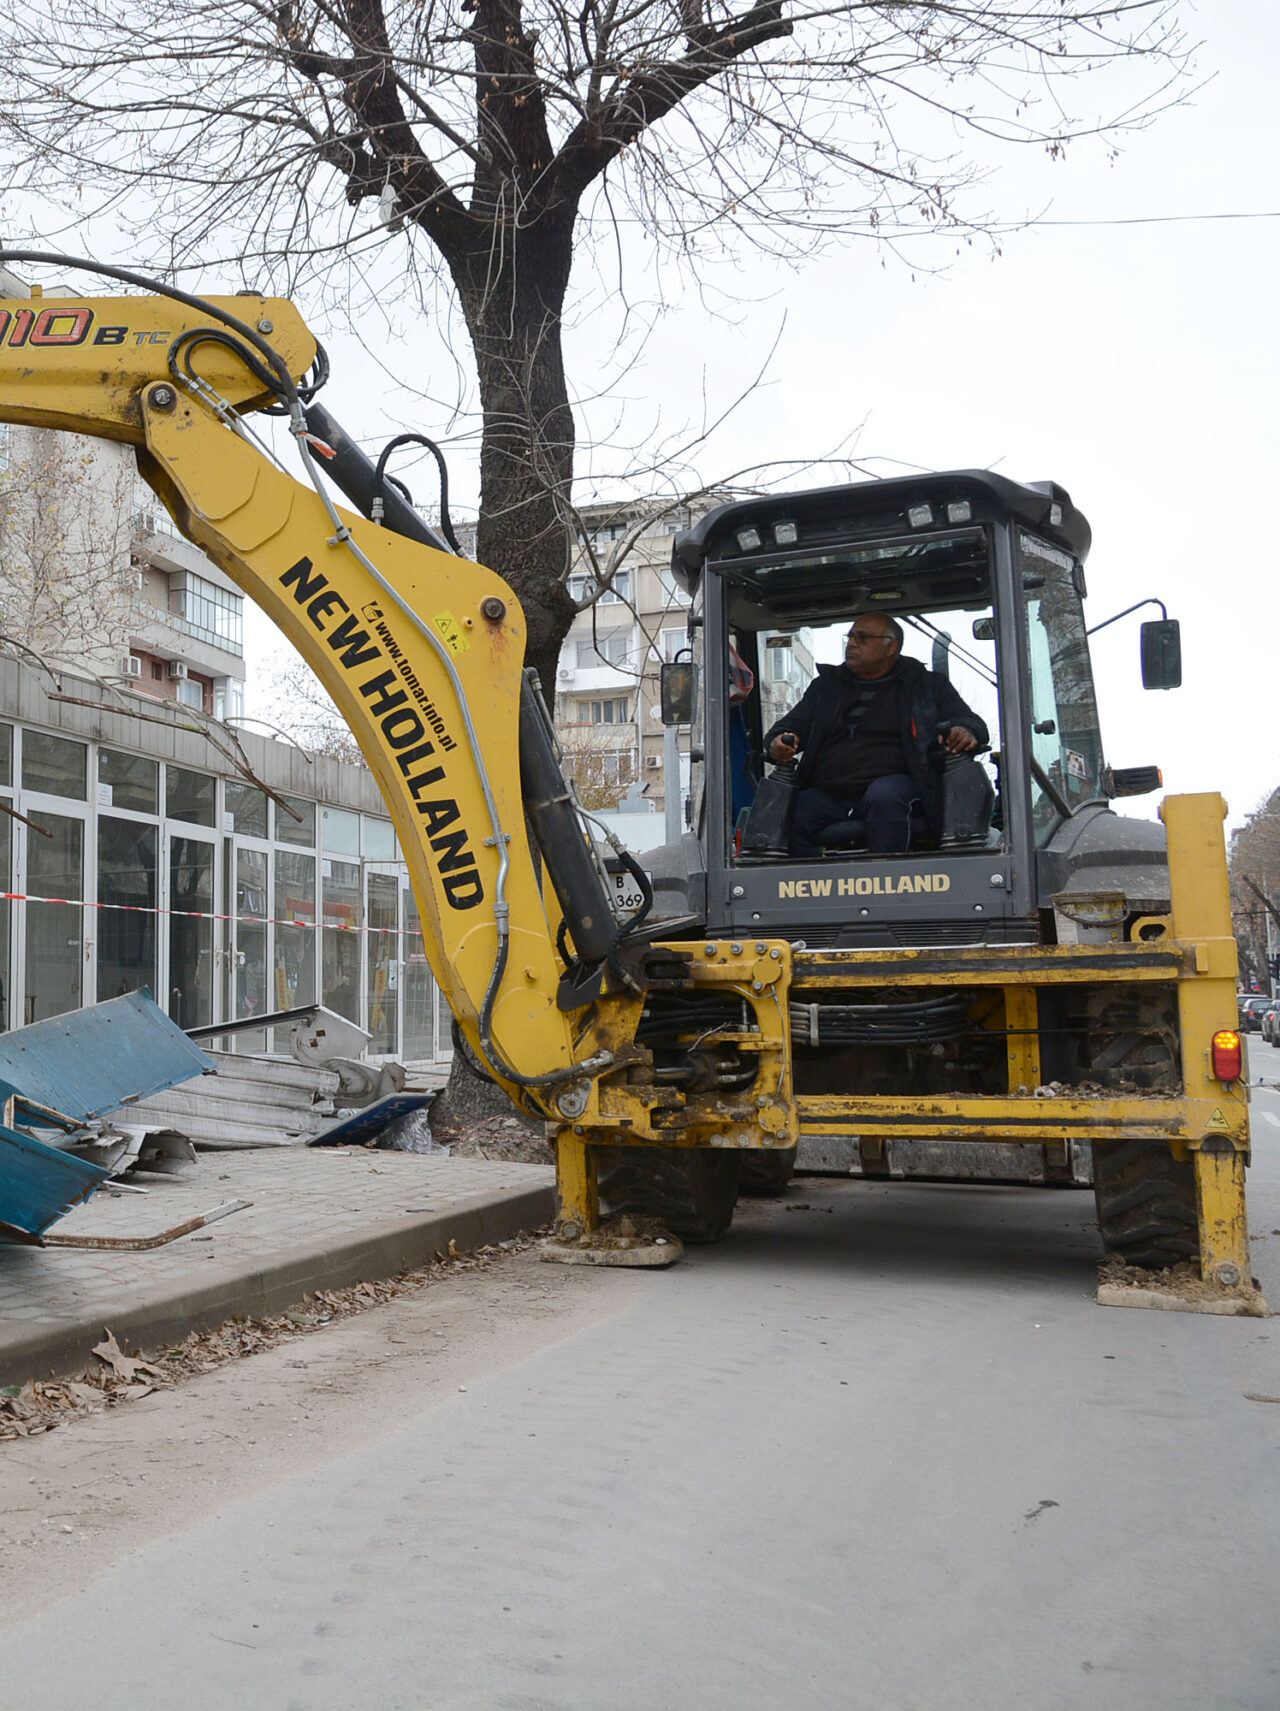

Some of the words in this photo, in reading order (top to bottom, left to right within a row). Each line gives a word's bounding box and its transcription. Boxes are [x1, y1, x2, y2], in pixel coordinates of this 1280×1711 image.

[278, 556, 382, 670] NEW
[358, 669, 485, 910] HOLLAND
[375, 621, 458, 752] www.tomar.info.pl
[778, 879, 832, 899] NEW
[837, 873, 951, 896] HOLLAND
